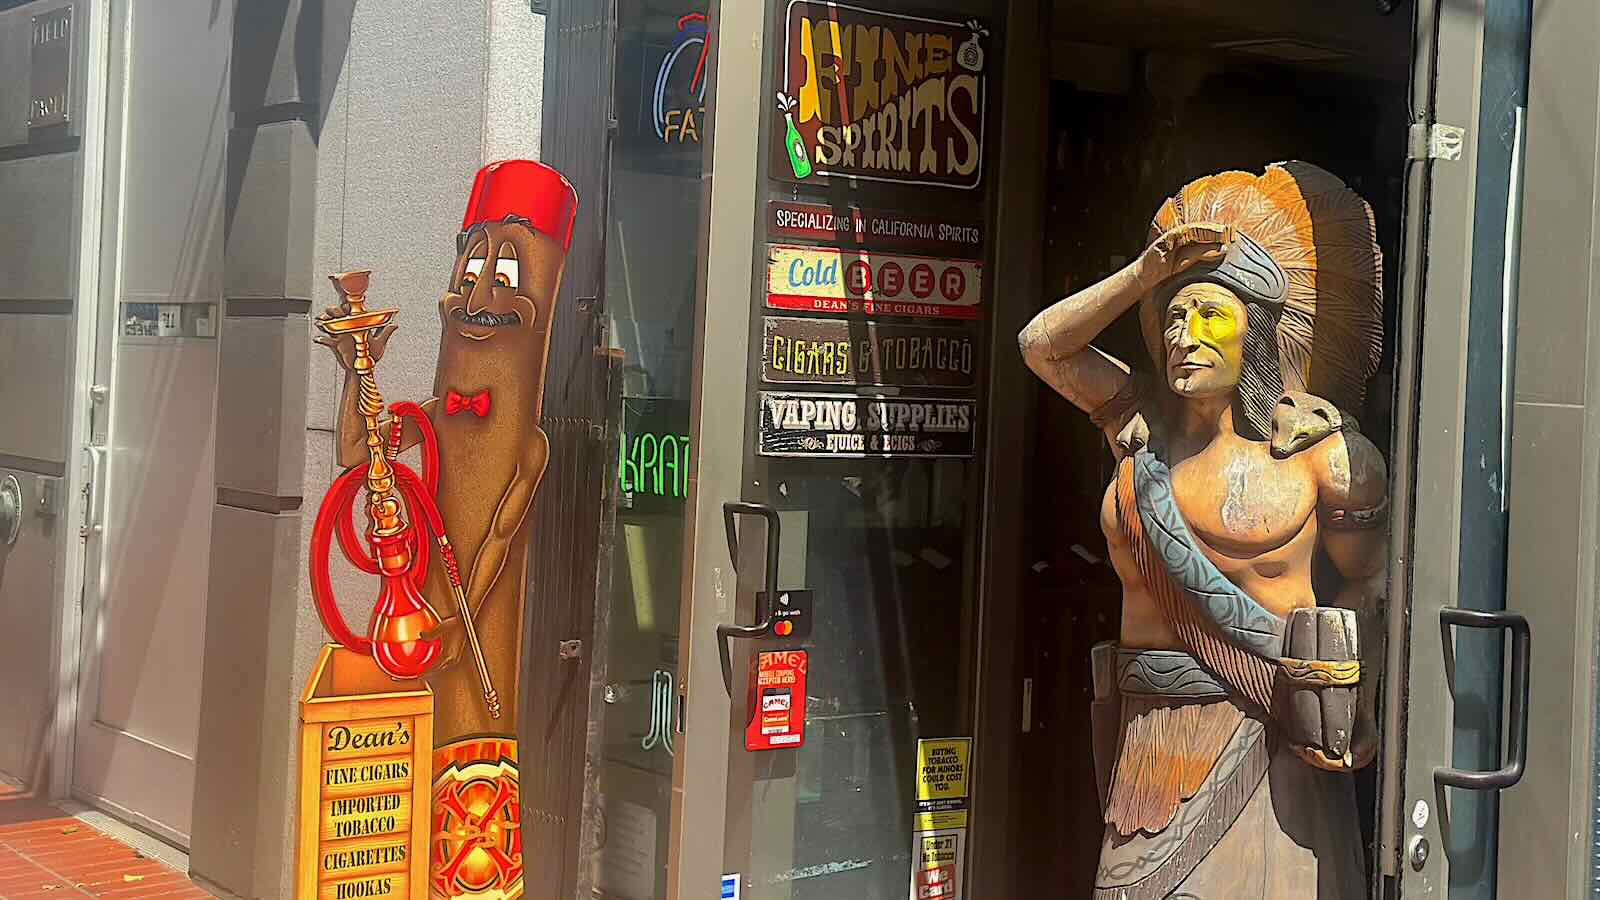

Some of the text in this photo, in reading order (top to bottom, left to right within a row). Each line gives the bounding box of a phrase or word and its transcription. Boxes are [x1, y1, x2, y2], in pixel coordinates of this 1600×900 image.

[799, 17, 953, 123] FINE
[815, 74, 980, 176] SPIRITS
[776, 209, 979, 243] SPECIALIZING IN CALIFORNIA SPIRITS
[788, 257, 963, 298] Cold BEER
[814, 299, 940, 316] DEAN'S FINE CIGARS
[772, 335, 850, 376] CIGARS
[881, 336, 973, 374] TOBACCO
[770, 400, 970, 432] VAPING SUPPLIES
[826, 433, 916, 453] EJUICE & ECIGS
[328, 721, 410, 751] Dean's
[922, 766, 937, 775] FOR
[928, 755, 959, 766] TOBACCO
[326, 762, 409, 785] FINE CIGARS
[922, 773, 963, 784] COULD COST
[331, 794, 401, 817] IMPORTED
[335, 816, 395, 837] TOBACCO
[324, 845, 406, 870] CIGARETTES
[336, 878, 392, 900] HOOKAS
